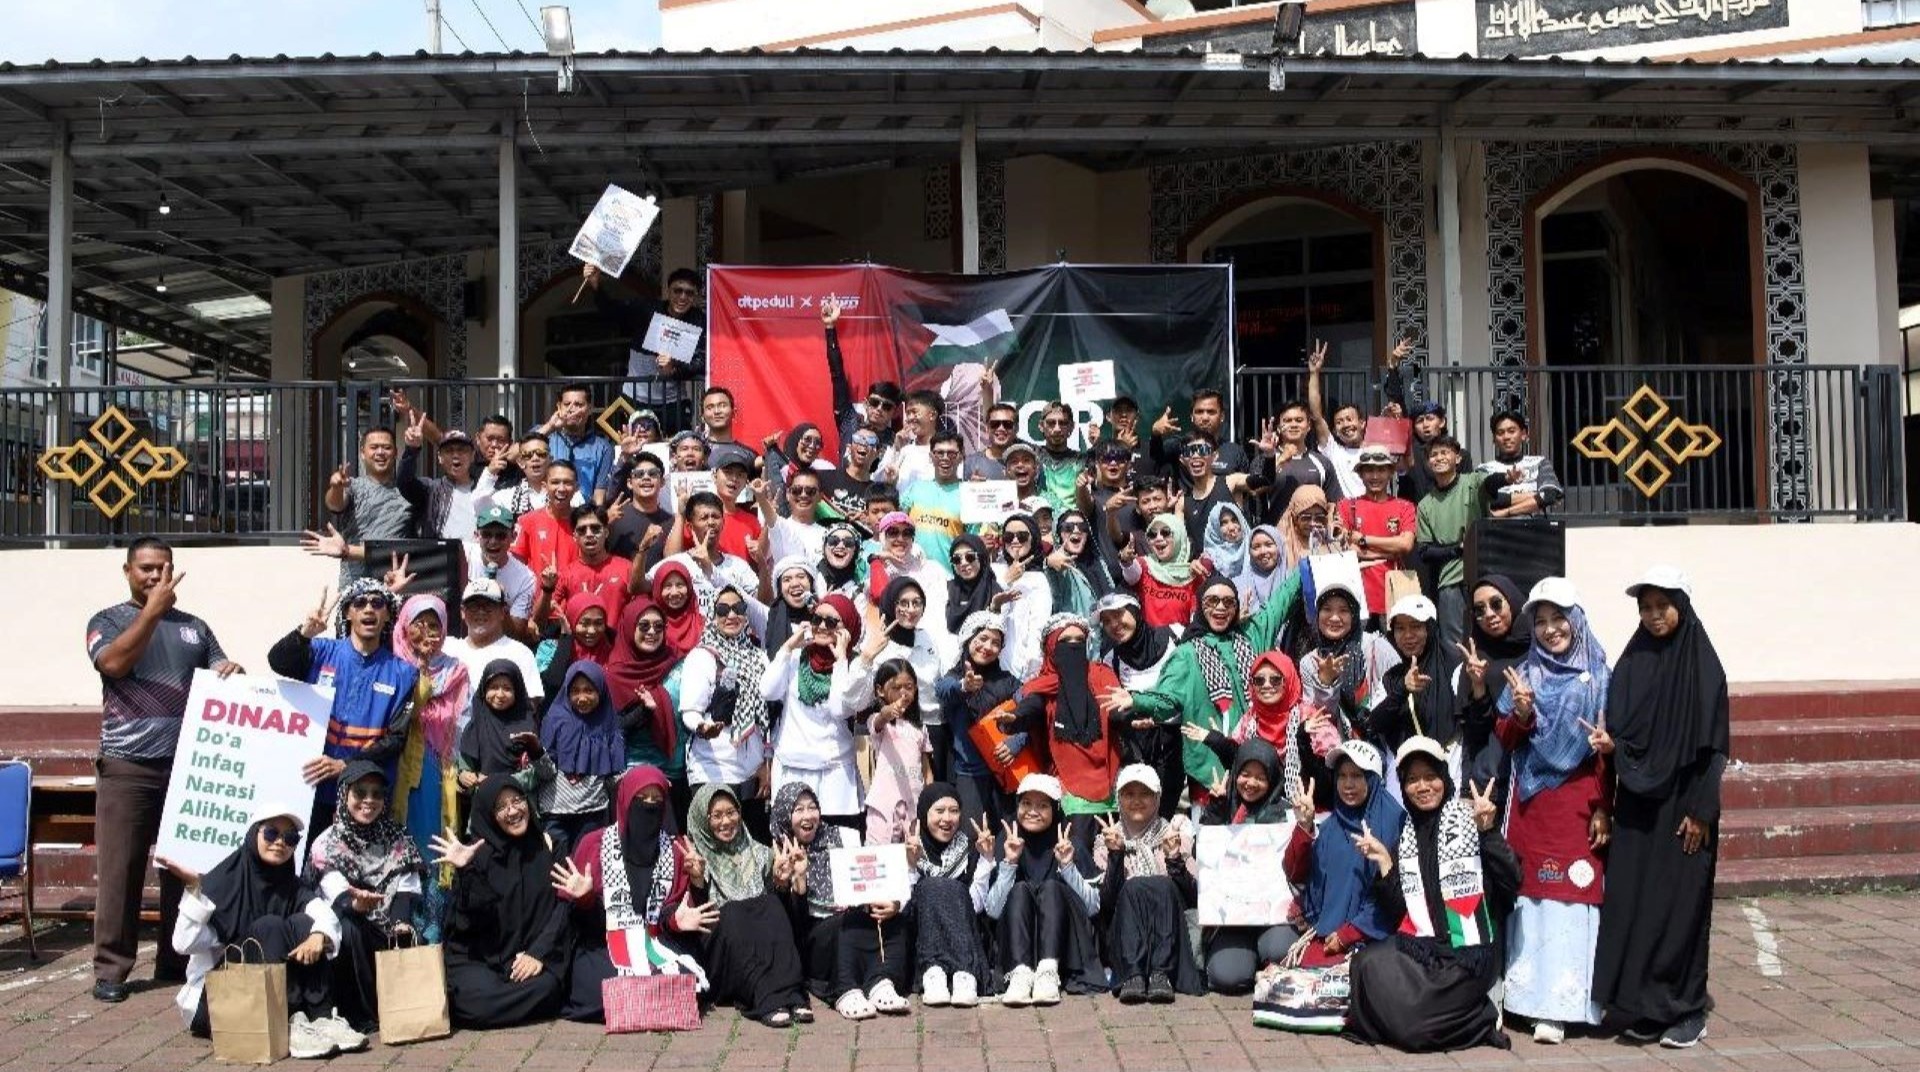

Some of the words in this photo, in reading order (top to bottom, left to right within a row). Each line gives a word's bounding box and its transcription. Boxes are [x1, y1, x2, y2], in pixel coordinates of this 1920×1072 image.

[202, 699, 310, 737] DINAR
[196, 727, 242, 749] Do'a
[191, 751, 246, 778] Infaq
[186, 774, 255, 800] Narasi
[179, 799, 253, 824] Alihka
[175, 824, 244, 849] Reflek
